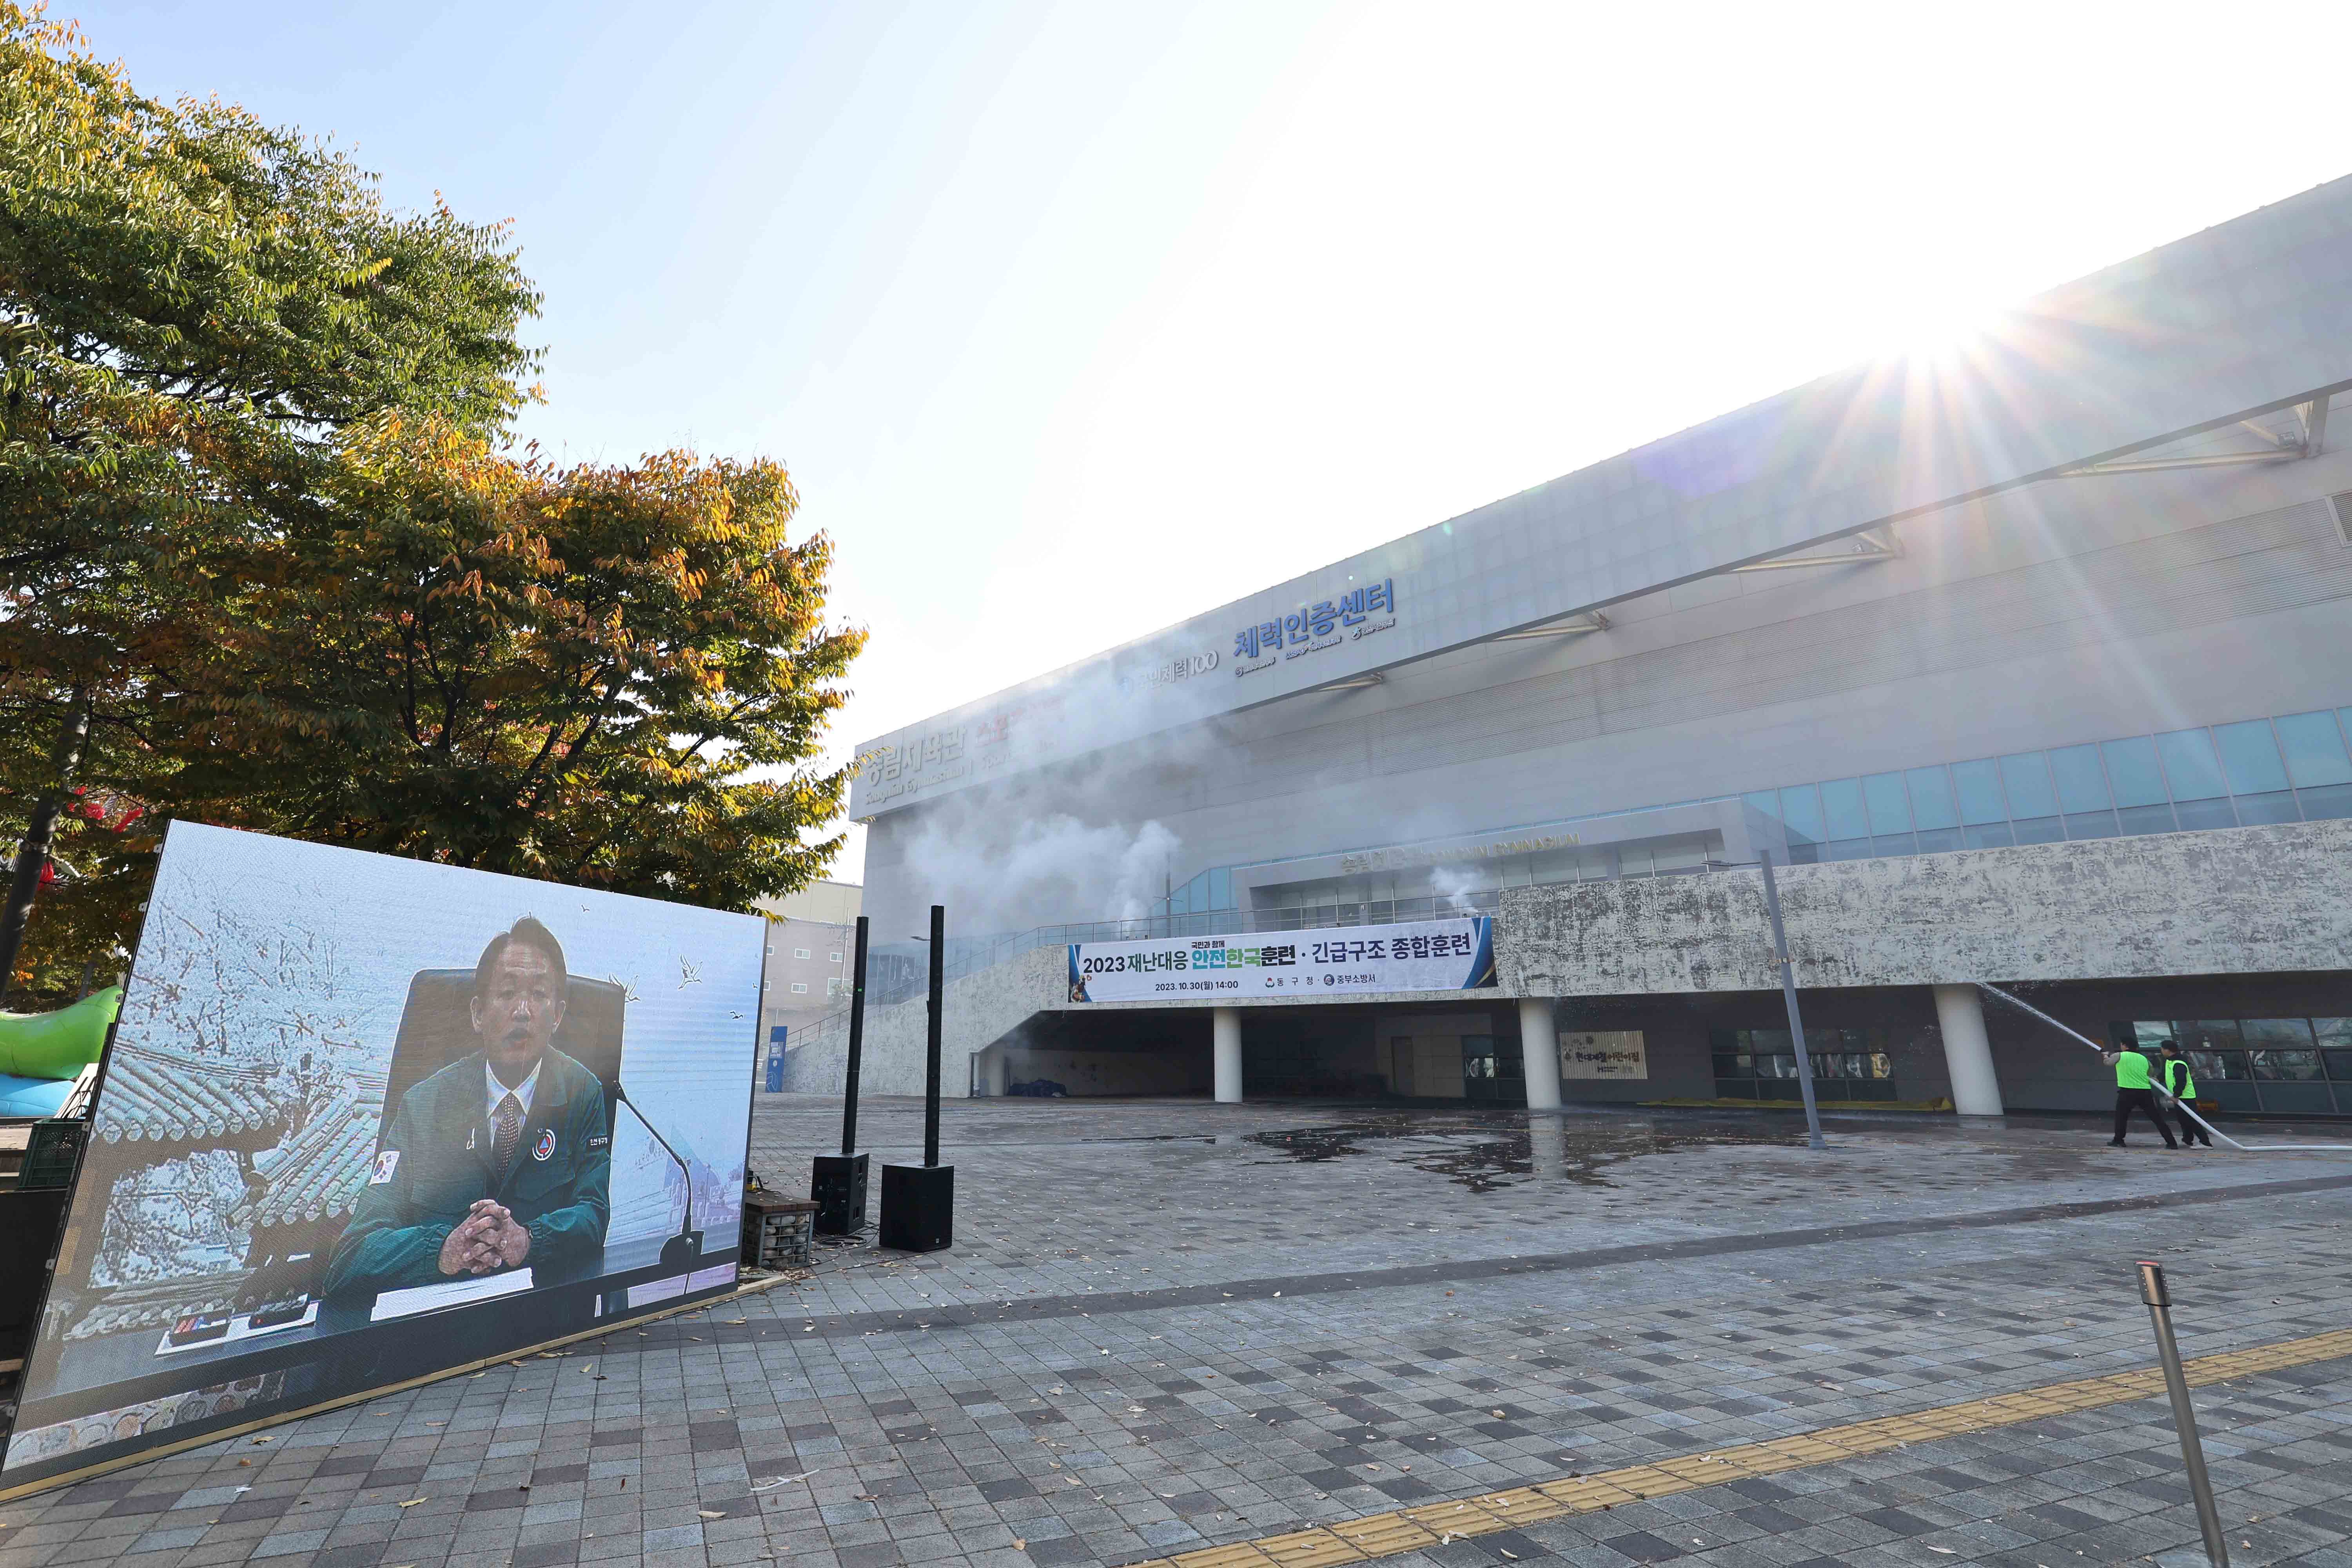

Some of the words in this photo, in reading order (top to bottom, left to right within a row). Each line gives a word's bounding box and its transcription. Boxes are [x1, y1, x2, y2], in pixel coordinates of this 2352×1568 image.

[1234, 578, 1394, 659] 체력인증센터
[1492, 832, 1581, 855] GYMNASIUM
[1192, 945, 1296, 970] 안전한국훈련
[1312, 940, 1387, 964] 긴급구조
[1391, 932, 1471, 960] 종합훈련
[1215, 980, 1238, 989] 14:00
[1337, 973, 1376, 984] 중부소방서
